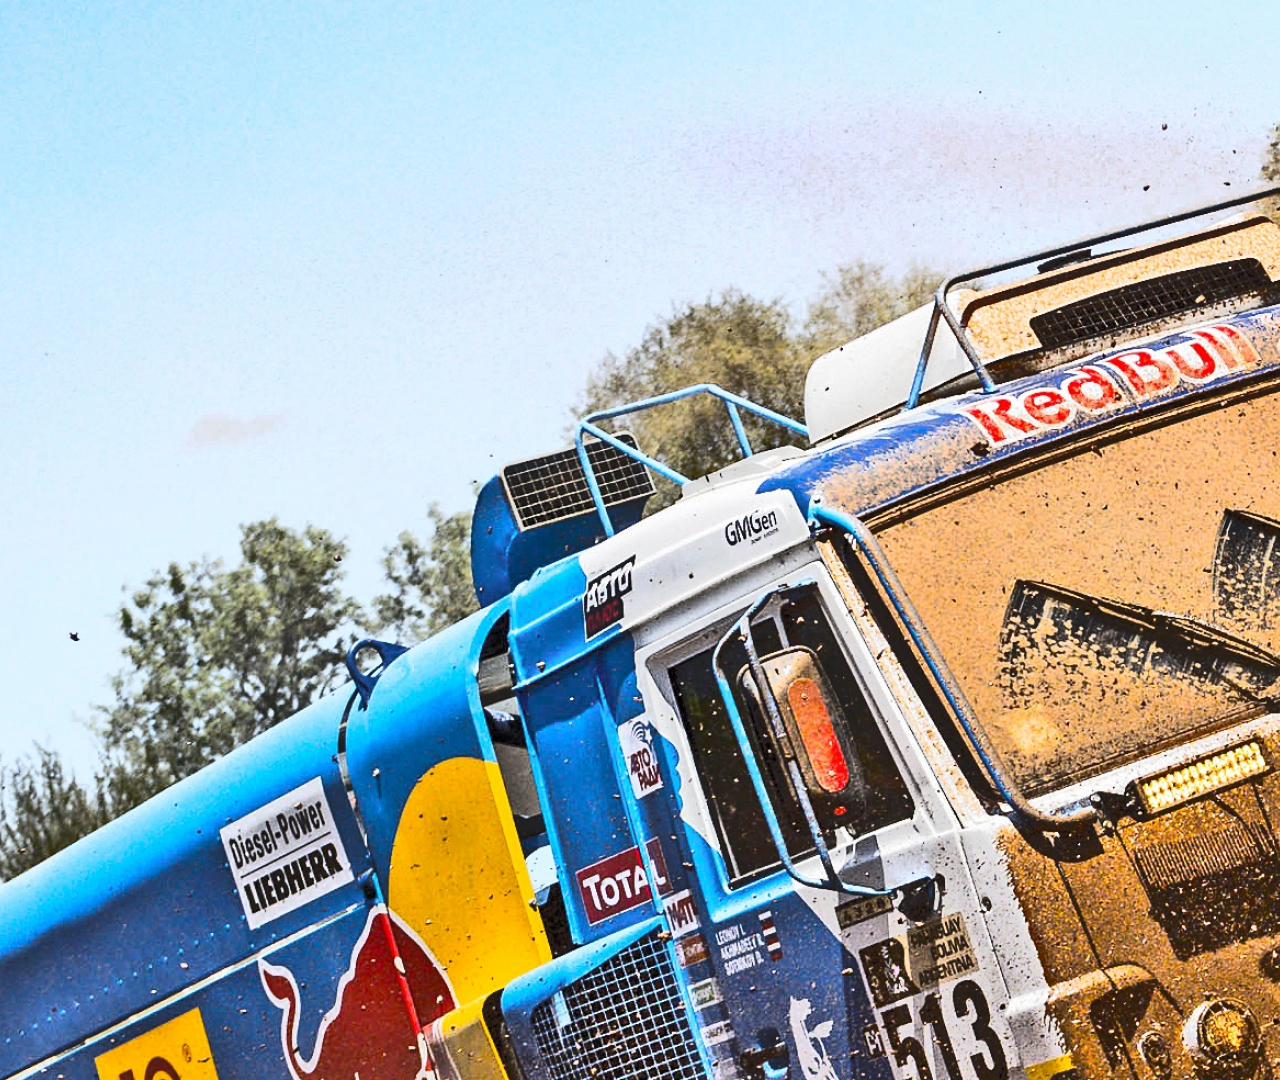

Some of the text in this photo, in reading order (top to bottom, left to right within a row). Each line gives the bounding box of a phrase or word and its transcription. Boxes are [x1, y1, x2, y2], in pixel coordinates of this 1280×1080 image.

[967, 323, 1262, 445] Red Bull
[724, 509, 778, 546] GMGen
[229, 800, 326, 870] Diesel-Power
[243, 842, 343, 914] LIEBHERR
[582, 858, 667, 911] TOTAL
